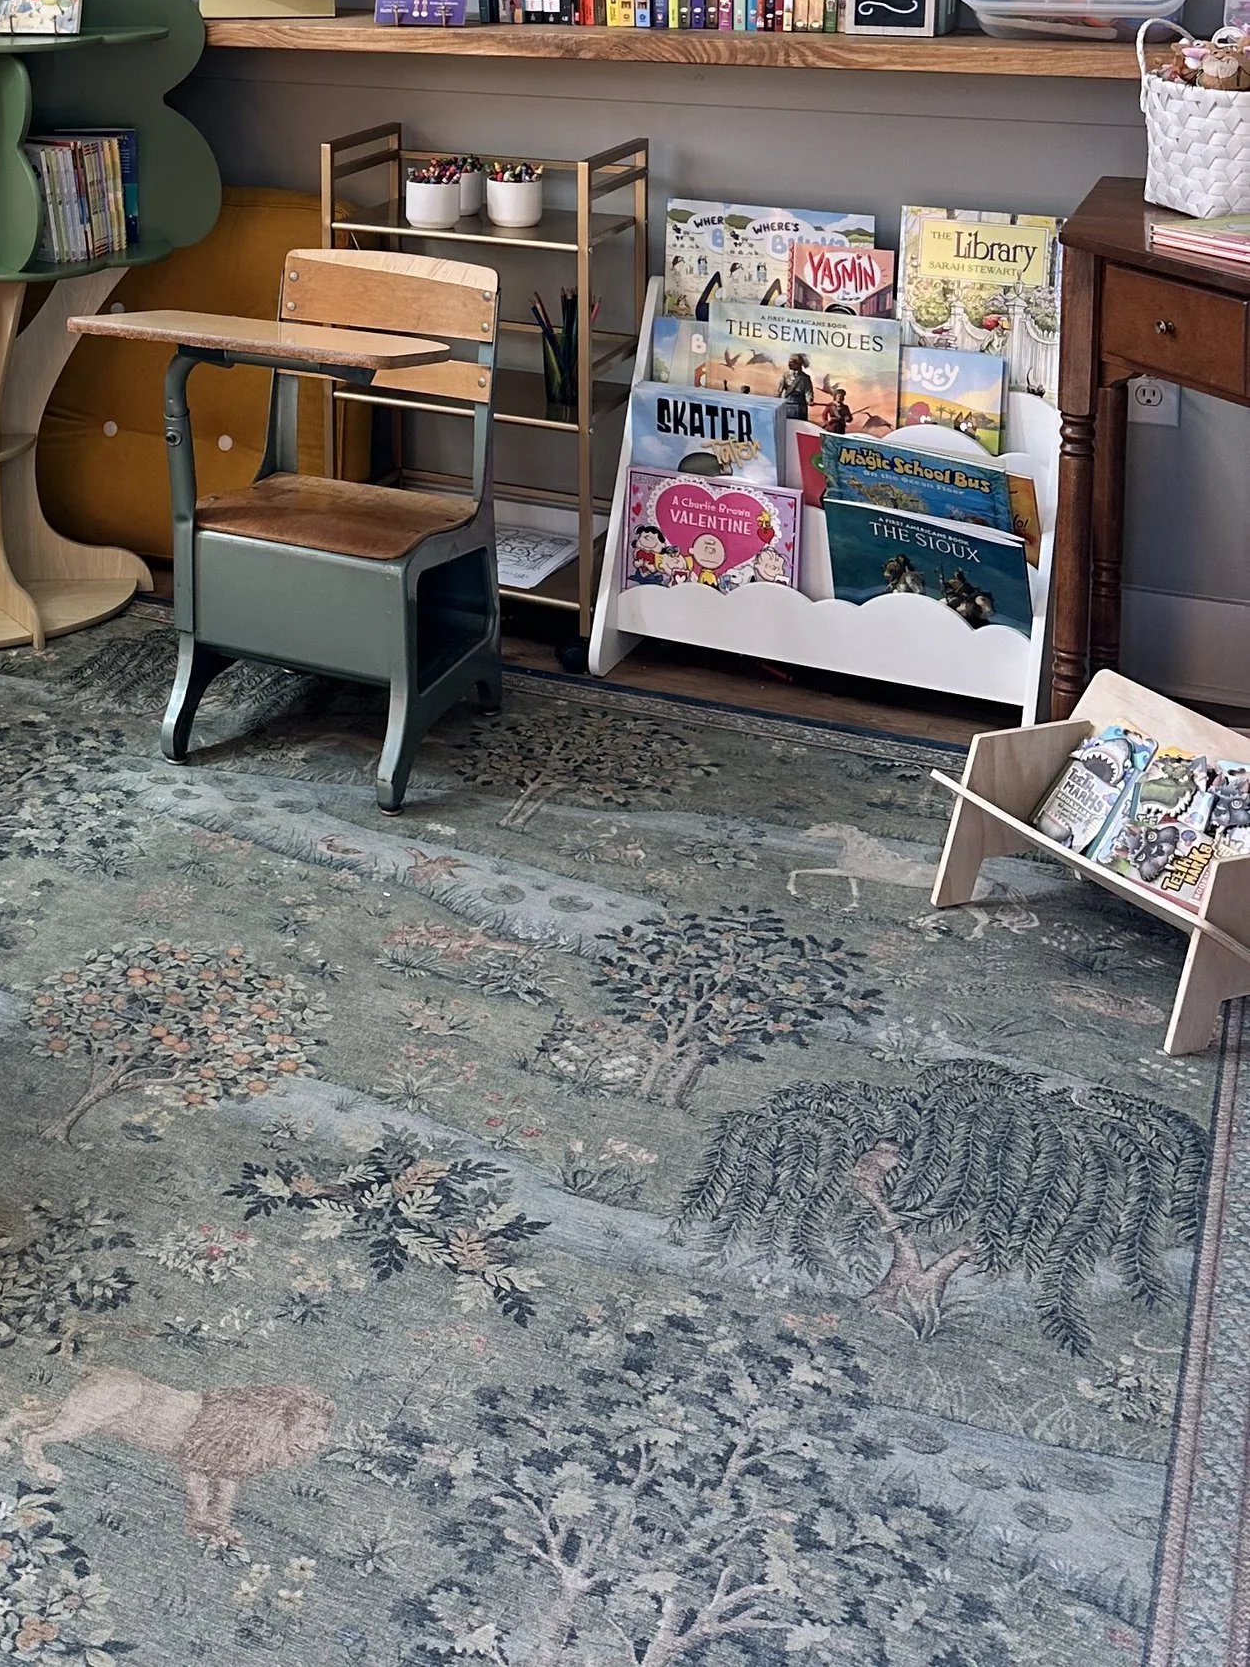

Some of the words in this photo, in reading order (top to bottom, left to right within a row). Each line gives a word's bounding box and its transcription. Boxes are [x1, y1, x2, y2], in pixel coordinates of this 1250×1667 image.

[752, 221, 800, 234] WHERE'S
[930, 231, 952, 240] THE
[954, 231, 1038, 272] Library
[929, 261, 965, 271] SARAH
[967, 265, 1017, 277] STEWART
[726, 319, 762, 338] THE
[767, 324, 883, 352] SEMINOLES
[657, 397, 754, 444] SKATER
[702, 437, 761, 469] Tater
[860, 449, 881, 459] The
[839, 447, 891, 471] Magic
[893, 457, 951, 483] School
[954, 472, 991, 493] Bus
[672, 496, 679, 506] A
[681, 498, 715, 512] Charlie
[718, 505, 750, 517] Brown
[670, 509, 752, 535] VALENTINE
[885, 518, 904, 528] FIRST
[869, 521, 911, 543] THE
[915, 532, 981, 564] SIOUX
